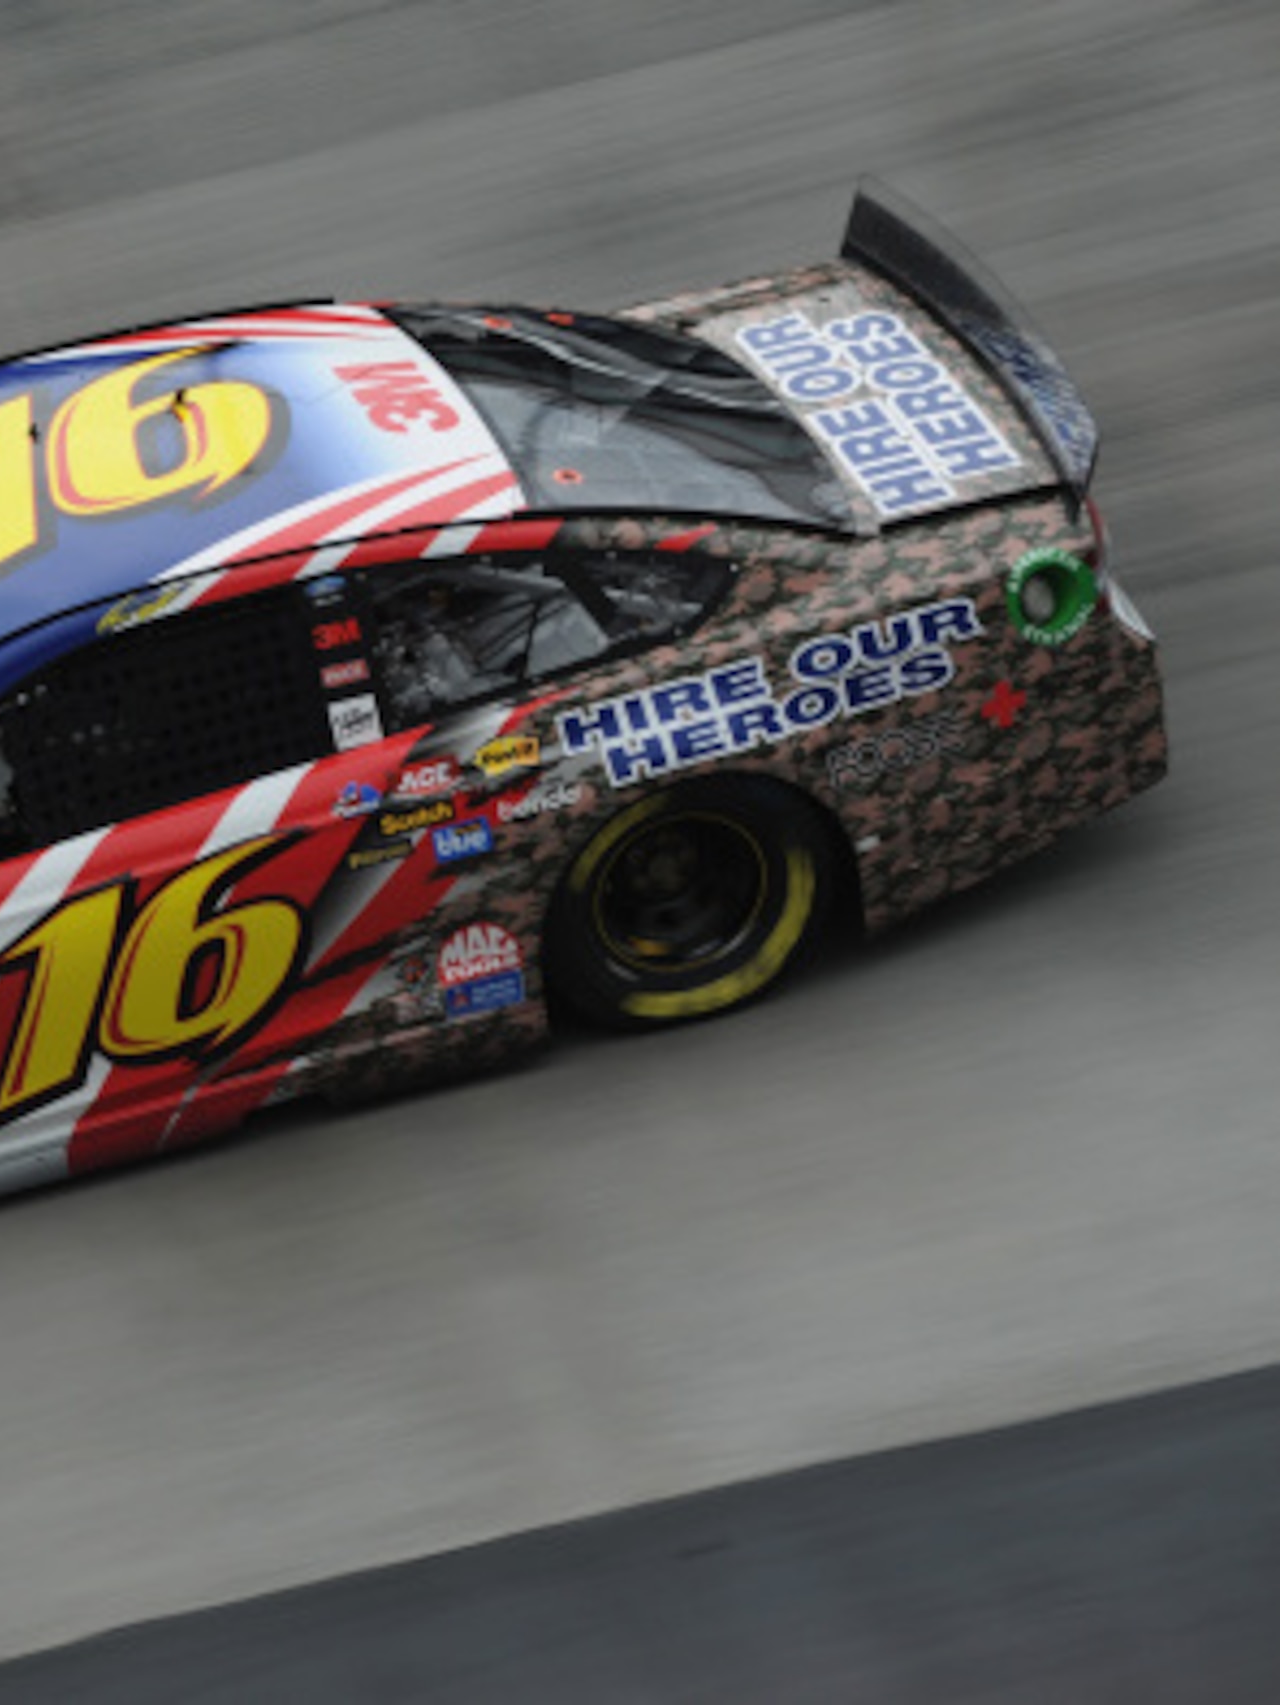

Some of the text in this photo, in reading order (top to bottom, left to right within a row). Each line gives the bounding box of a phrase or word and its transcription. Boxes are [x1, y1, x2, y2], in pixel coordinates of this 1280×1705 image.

[332, 360, 460, 434] 3M
[740, 314, 954, 512] HIRE OUR
[828, 312, 1014, 475] HEROES
[311, 616, 362, 650] 3M
[563, 599, 982, 752] HIRE OUR
[606, 651, 953, 785] HEROES
